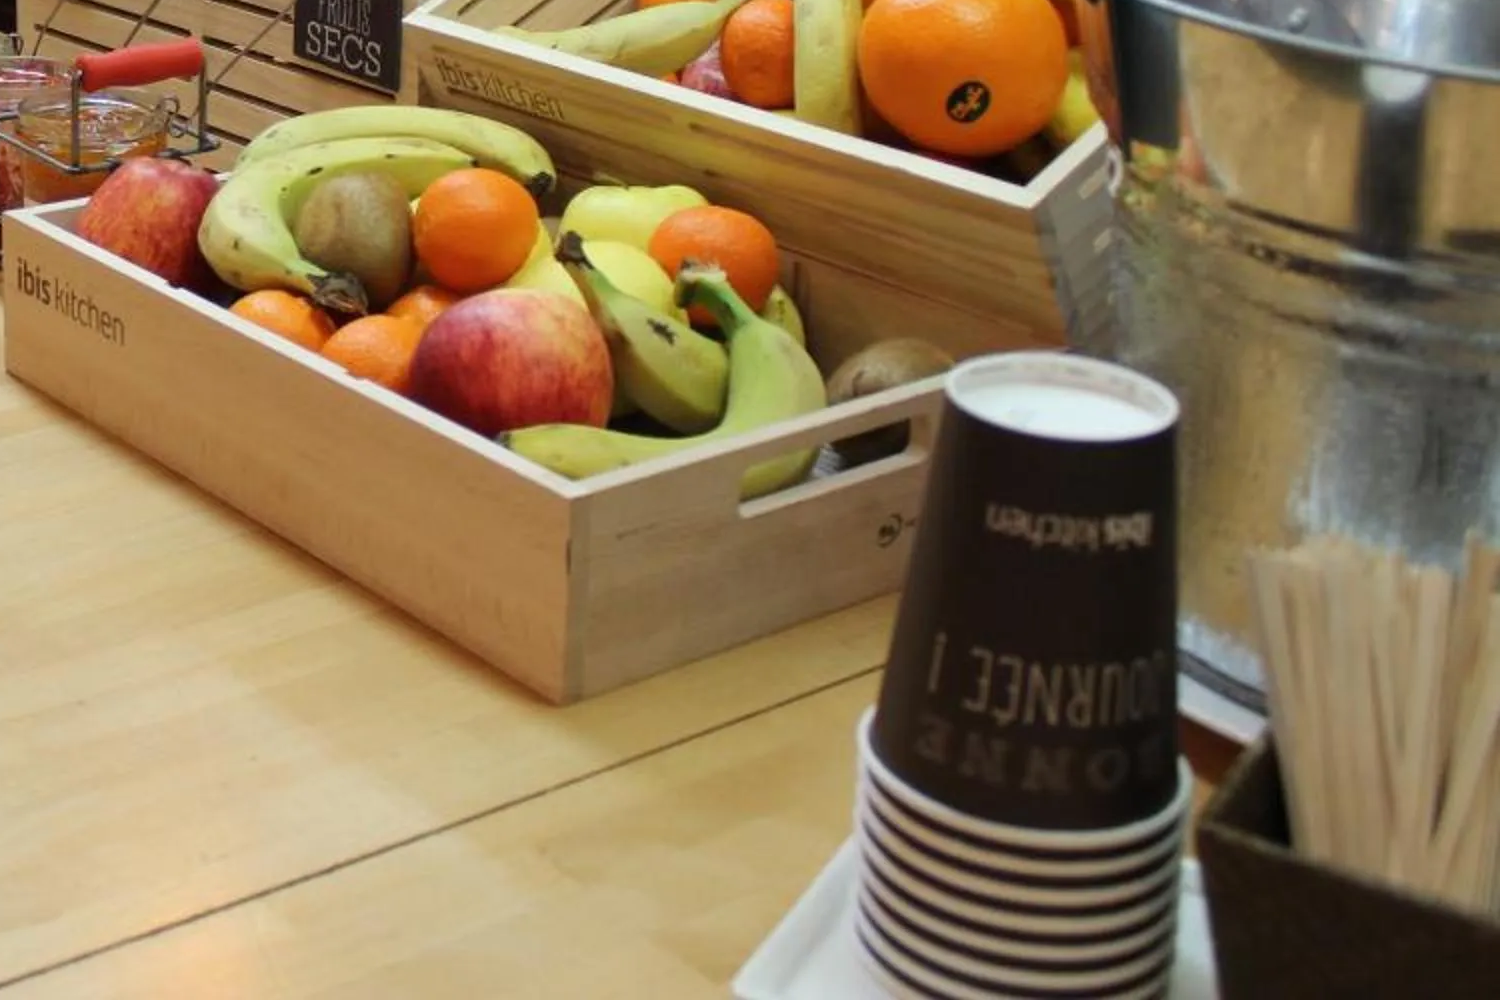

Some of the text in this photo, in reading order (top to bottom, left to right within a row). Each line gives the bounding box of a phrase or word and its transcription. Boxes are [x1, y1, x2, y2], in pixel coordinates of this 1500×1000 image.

[305, 20, 383, 77] SECS
[435, 55, 566, 121] ibis kitchen
[17, 256, 126, 347] ibis kitchen
